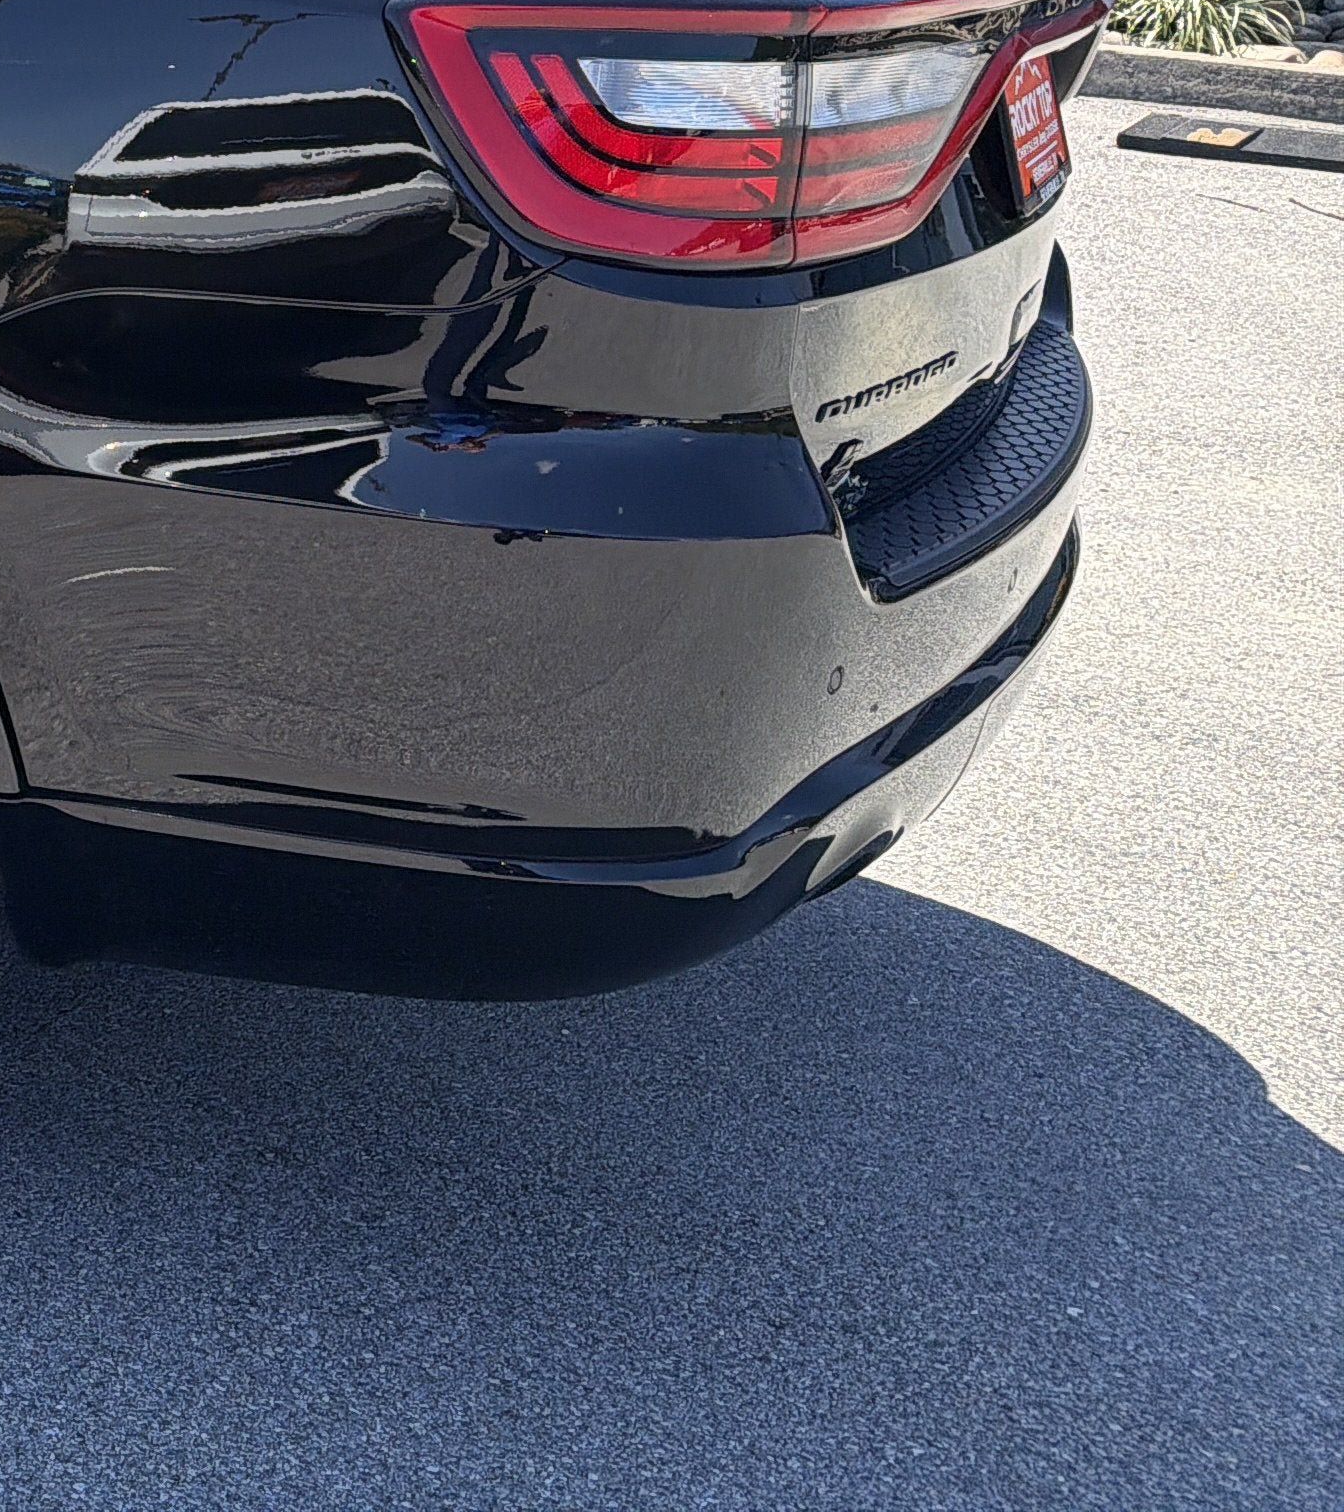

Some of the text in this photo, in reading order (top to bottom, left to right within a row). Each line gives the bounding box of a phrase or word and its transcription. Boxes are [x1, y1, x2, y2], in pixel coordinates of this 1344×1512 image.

[1008, 91, 1040, 140] ROCKY
[1036, 79, 1053, 121] TOP
[815, 350, 959, 423] DURANGO
